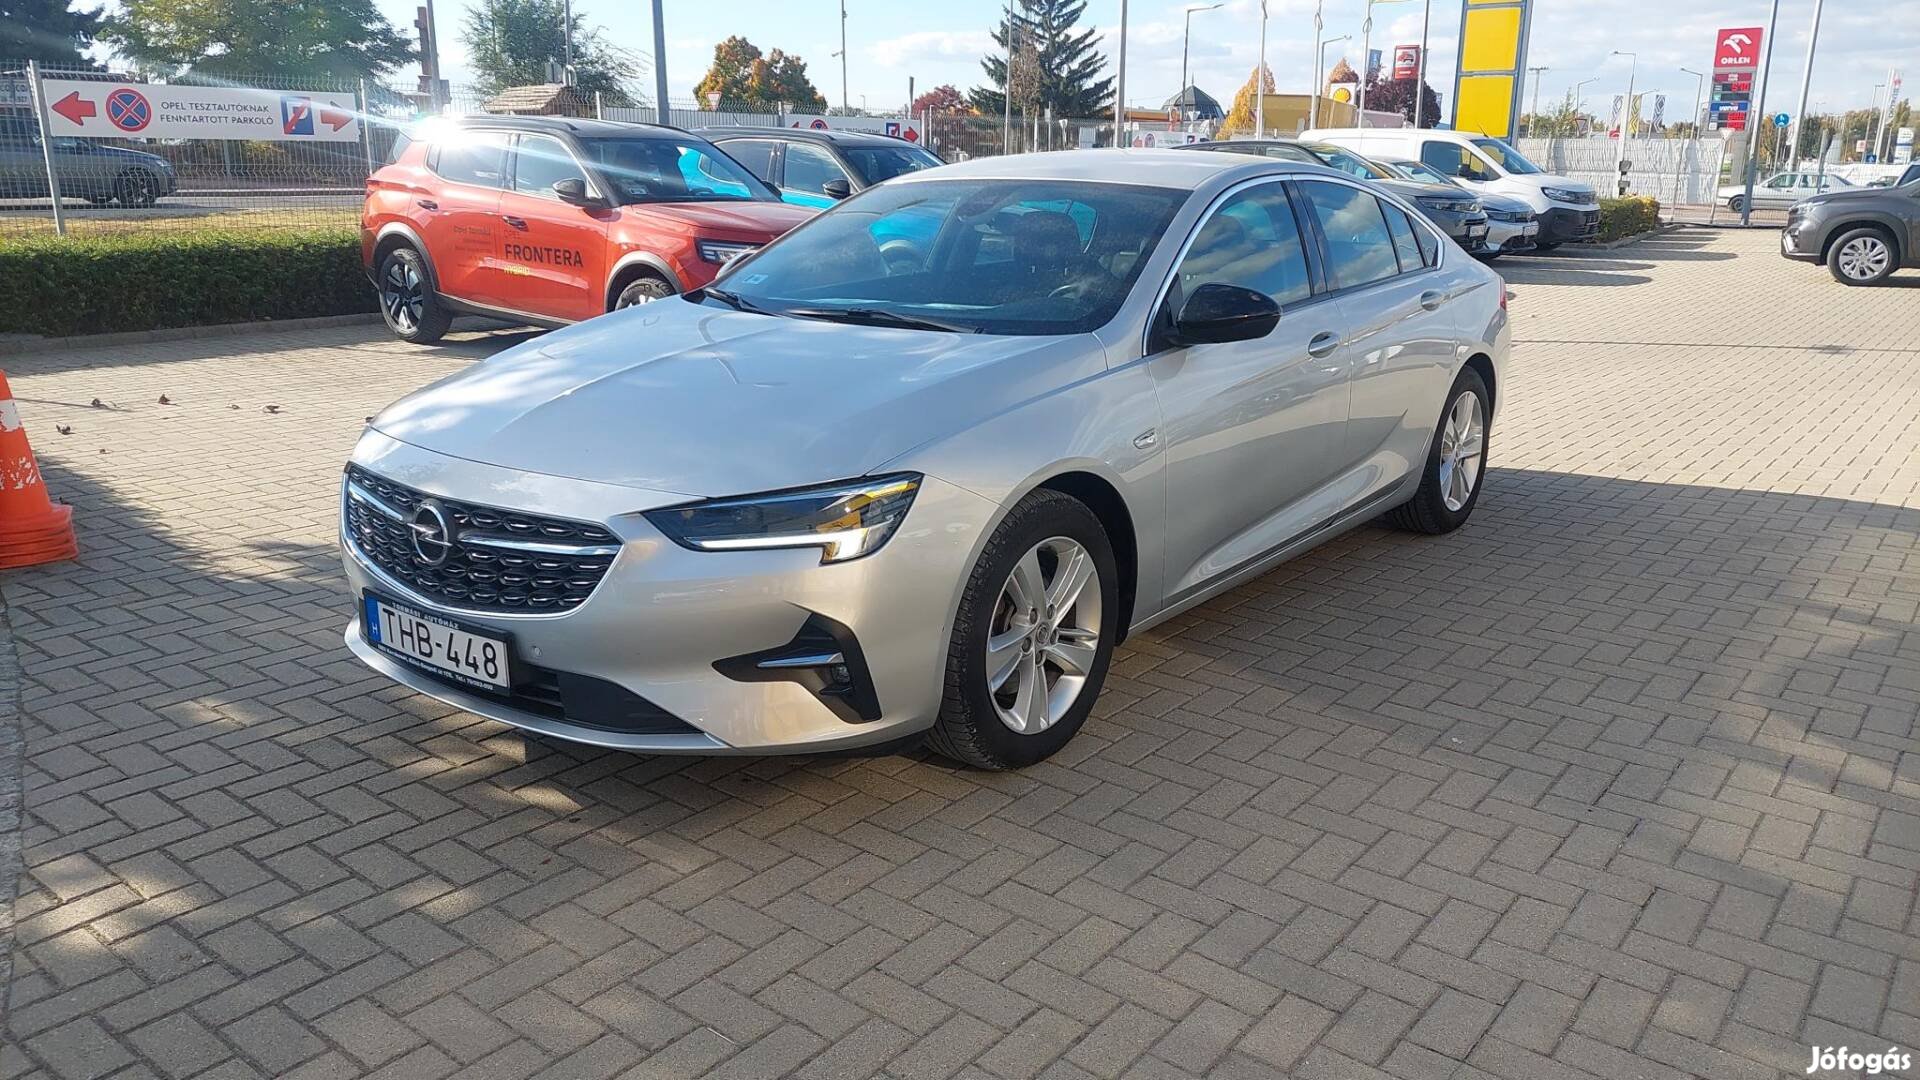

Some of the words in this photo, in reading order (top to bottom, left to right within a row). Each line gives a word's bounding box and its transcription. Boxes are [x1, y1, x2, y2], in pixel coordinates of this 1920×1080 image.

[1721, 57, 1750, 65] ORLEN
[161, 101, 186, 111] OPEL
[189, 101, 270, 113] TESZTAUTÓKNAK
[160, 114, 229, 125] FENNTARTOTT
[231, 113, 274, 126] PARKOLÓ
[504, 243, 584, 268] FRONTERA
[372, 622, 378, 636] H
[382, 607, 499, 680] THB-448
